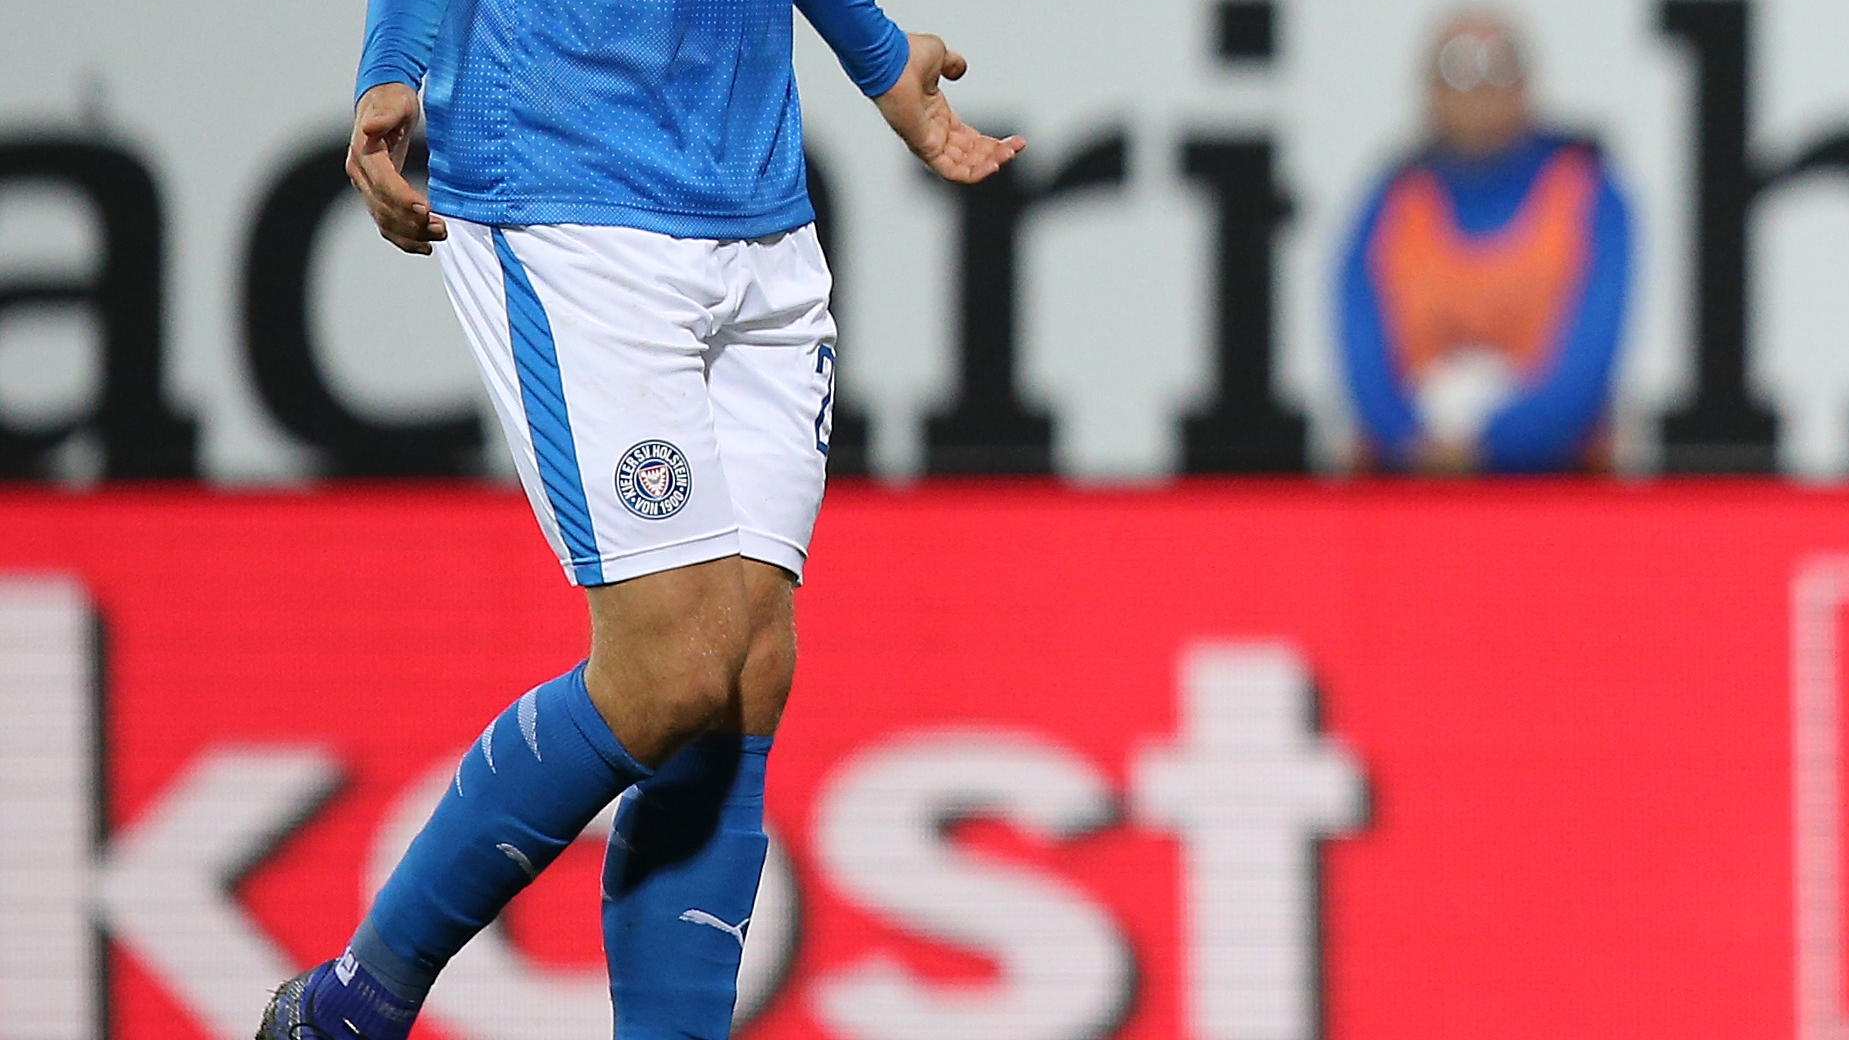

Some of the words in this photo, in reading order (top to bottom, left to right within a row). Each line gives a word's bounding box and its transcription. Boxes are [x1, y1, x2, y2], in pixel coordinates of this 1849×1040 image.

[620, 456, 639, 499] KIELER
[653, 444, 688, 487] HOLSTEIN
[634, 496, 658, 515] VON
[659, 490, 684, 514] 1900
